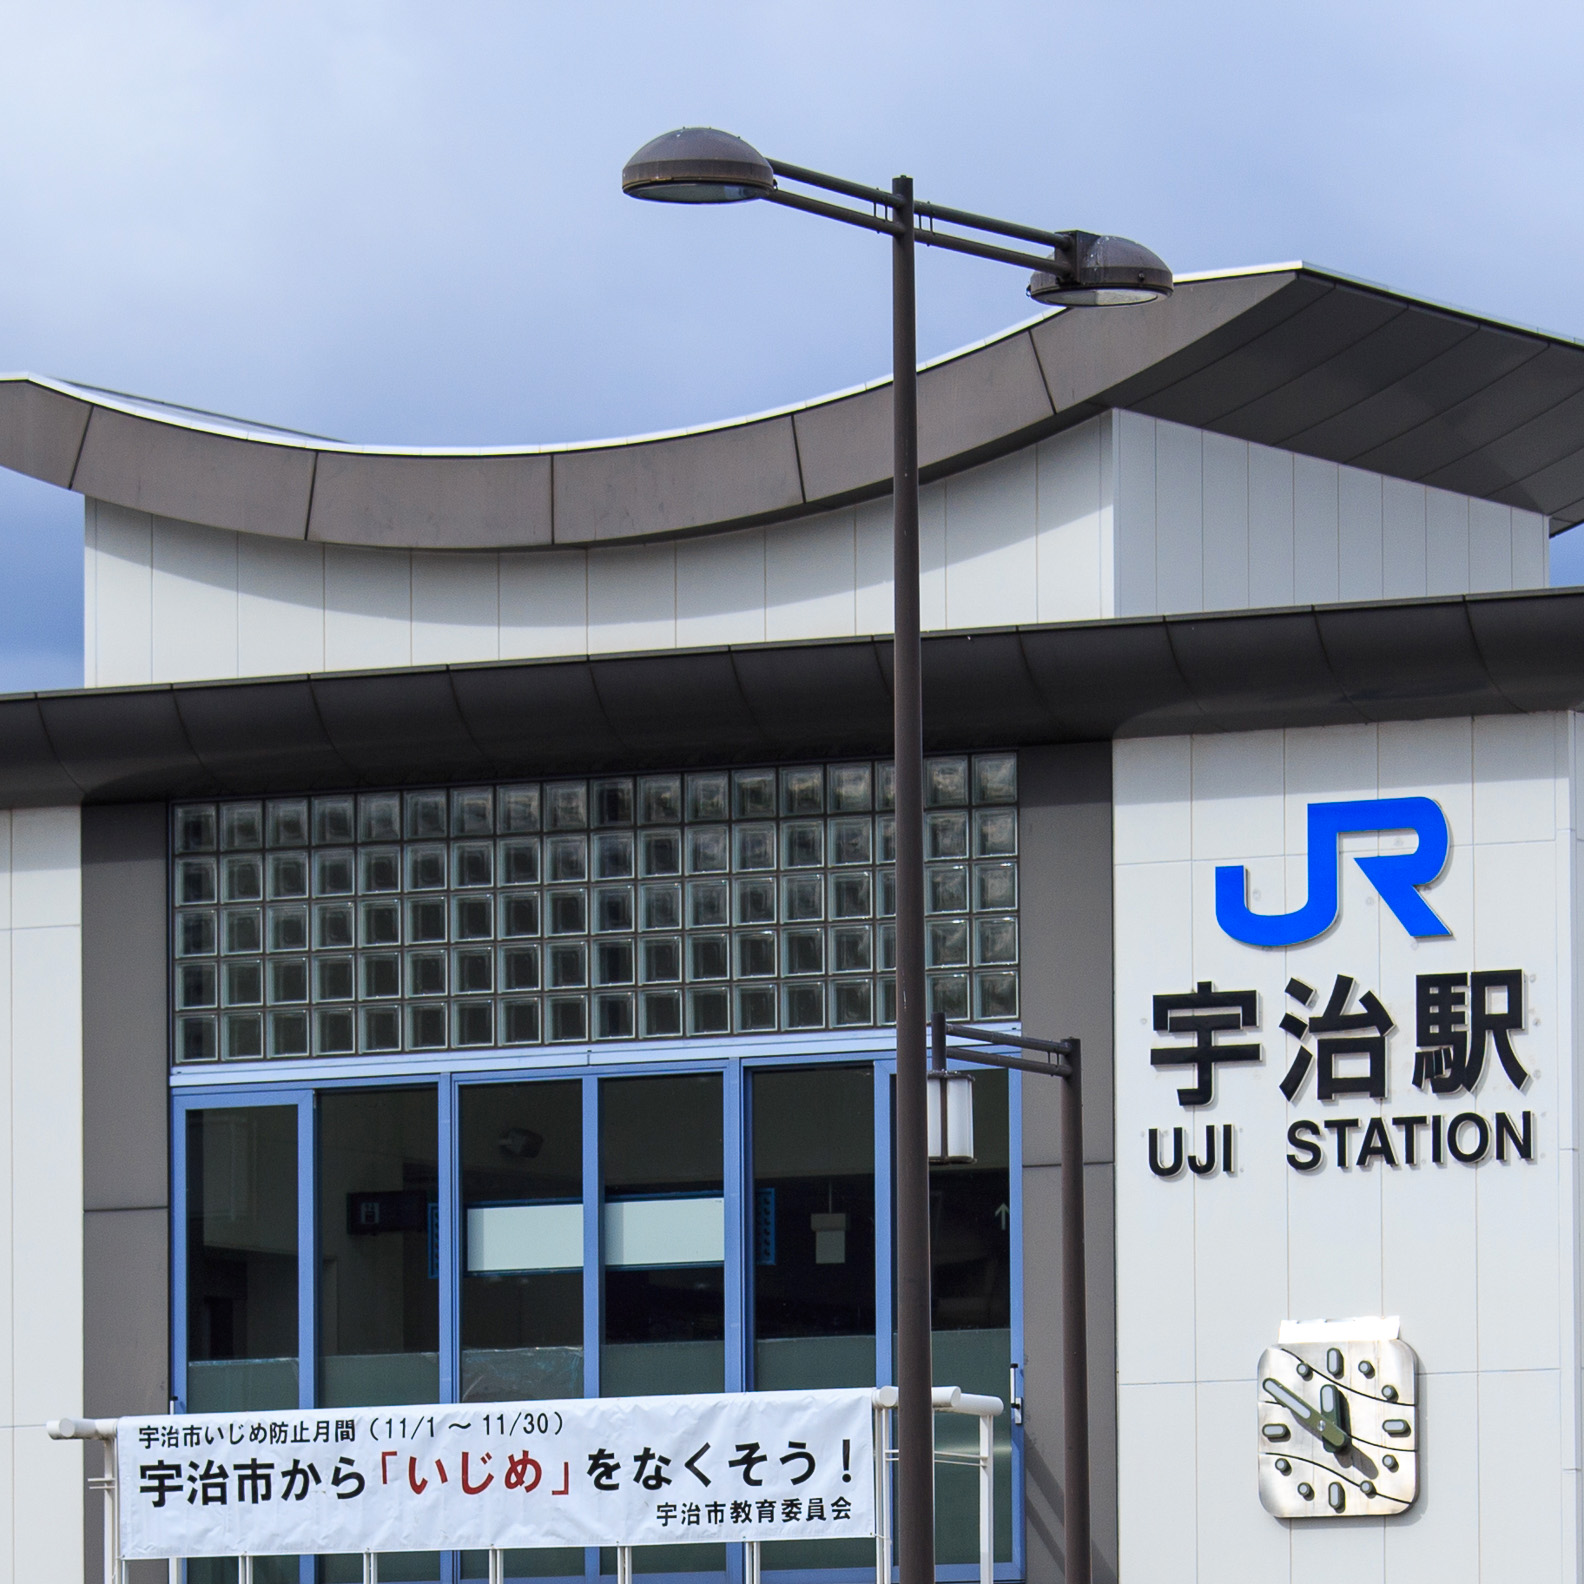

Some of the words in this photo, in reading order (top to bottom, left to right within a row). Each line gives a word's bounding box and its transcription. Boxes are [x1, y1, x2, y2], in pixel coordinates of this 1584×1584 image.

[1215, 796, 1453, 947] JR
[1150, 969, 1529, 1106] 宇治駅
[1148, 1124, 1236, 1177] UJI
[1286, 1110, 1534, 1171] STATION
[656, 1496, 852, 1526] 宇治市教育委員会
